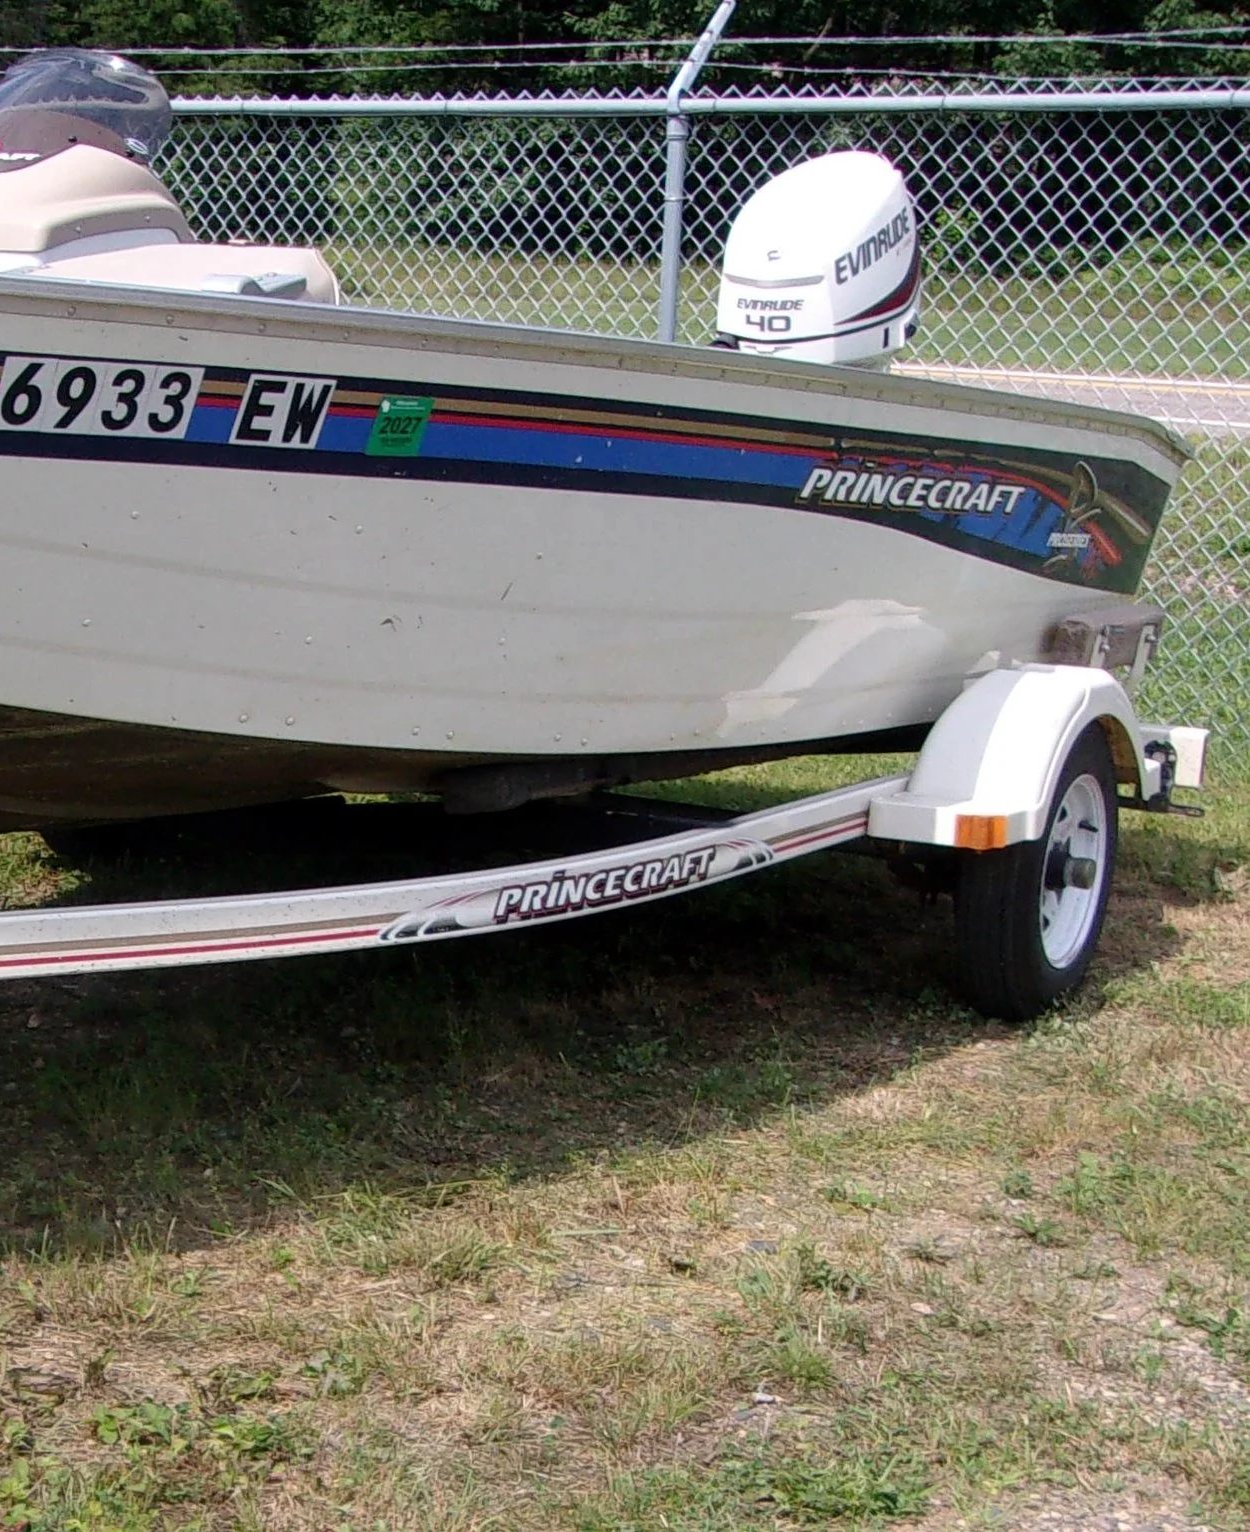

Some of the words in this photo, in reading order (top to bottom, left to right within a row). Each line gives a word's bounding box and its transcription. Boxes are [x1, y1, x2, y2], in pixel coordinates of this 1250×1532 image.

[833, 206, 911, 285] EVINRUDE
[736, 298, 805, 311] EVINRUDE
[745, 314, 792, 333] 40
[1, 362, 192, 433] 6933
[235, 379, 333, 444] EW
[379, 415, 423, 434] 2027
[798, 461, 1026, 515] PRINCECRAFT
[493, 845, 716, 922] PRINCECRAFT
